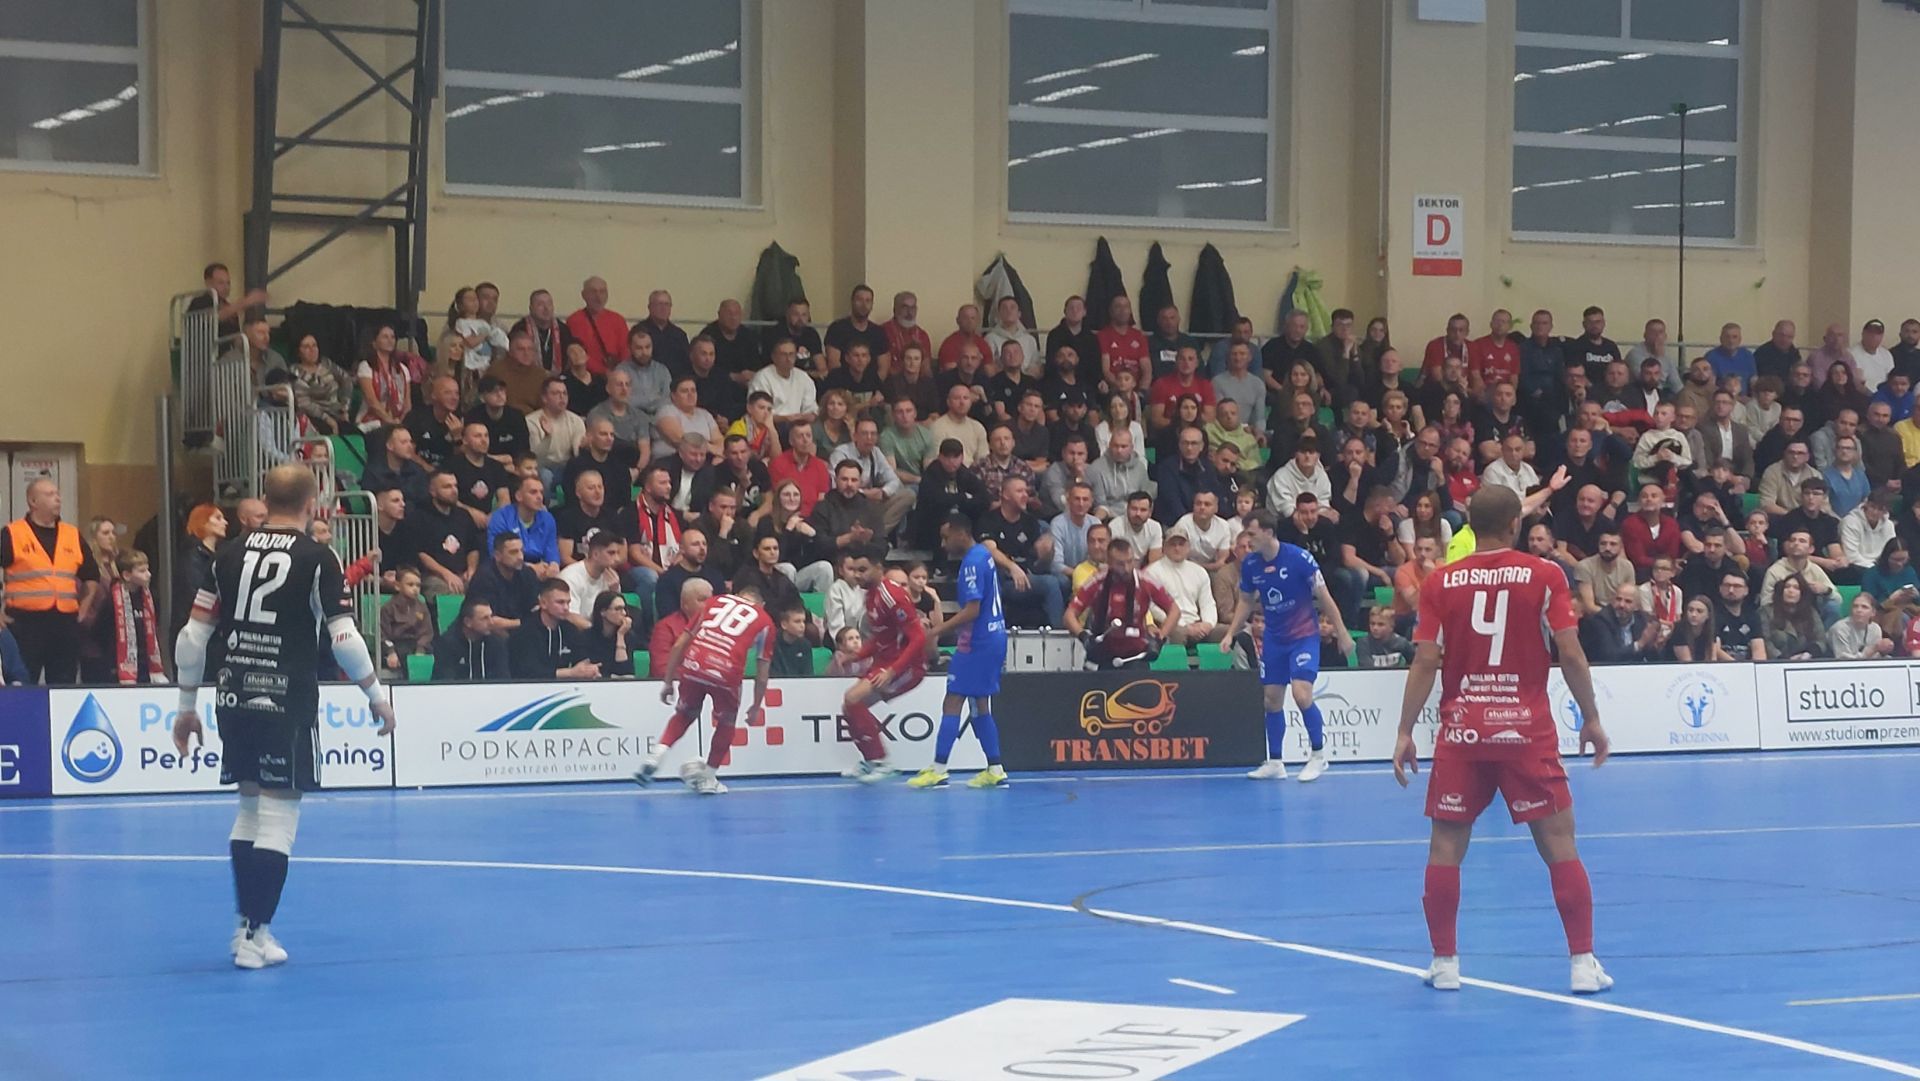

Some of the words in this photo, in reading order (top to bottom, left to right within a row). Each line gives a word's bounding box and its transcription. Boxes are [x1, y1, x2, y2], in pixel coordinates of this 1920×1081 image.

[1418, 198, 1459, 208] SEKTOR
[1427, 213, 1451, 246] D
[234, 550, 292, 625] 12
[1443, 568, 1469, 588] LEO
[1470, 566, 1532, 586] SANTANA
[701, 597, 759, 636] 38
[1471, 589, 1510, 666] 4
[1800, 682, 1885, 711] studio
[441, 735, 656, 761] PODKARPACKIE
[1051, 737, 1209, 763] TRANSBET
